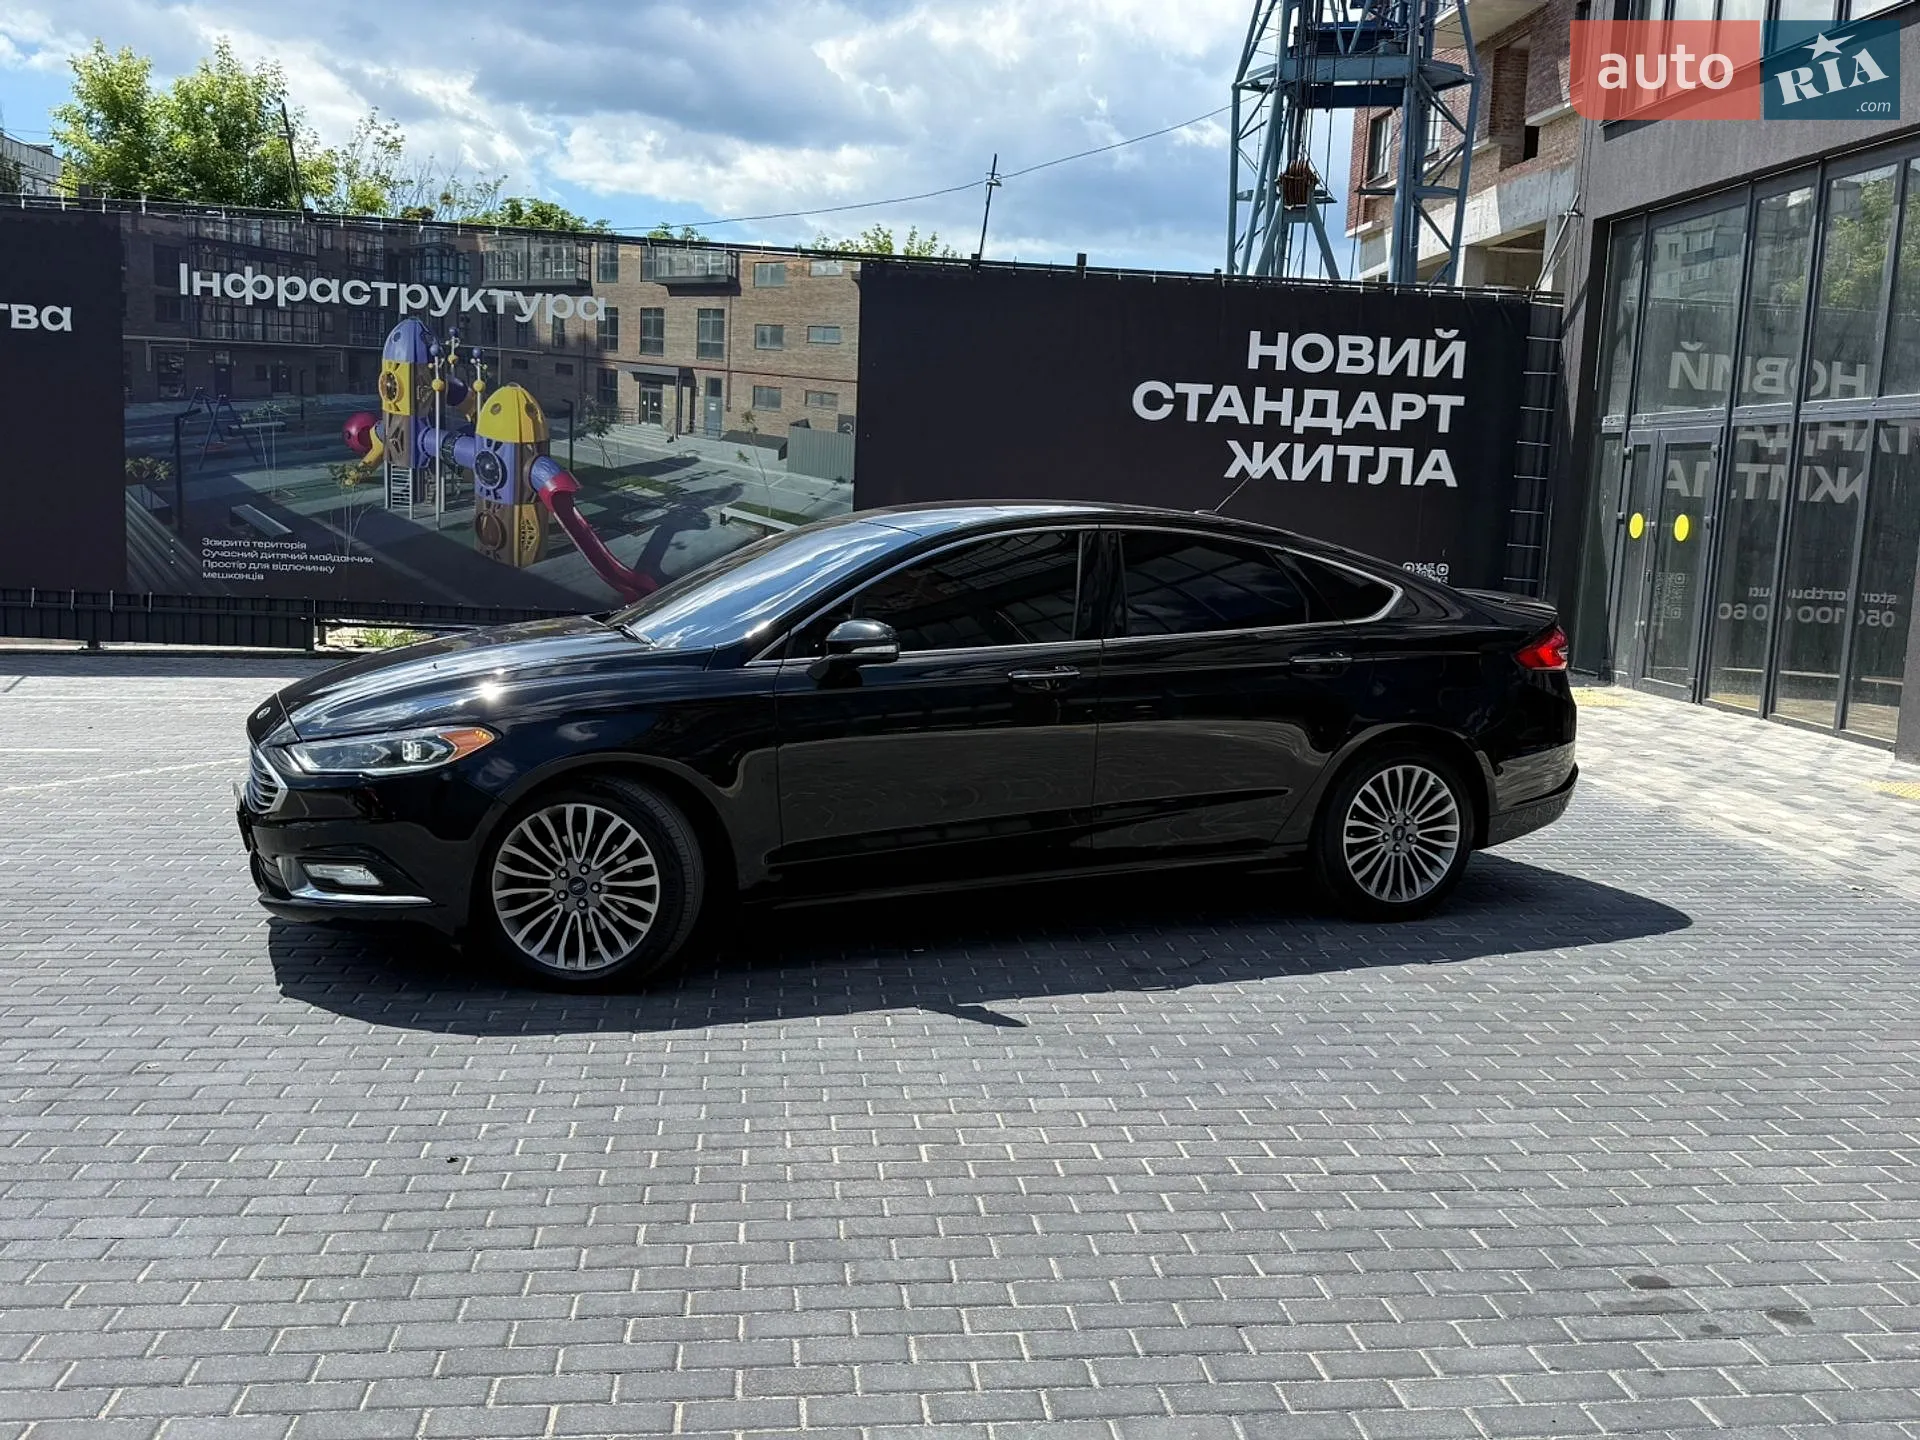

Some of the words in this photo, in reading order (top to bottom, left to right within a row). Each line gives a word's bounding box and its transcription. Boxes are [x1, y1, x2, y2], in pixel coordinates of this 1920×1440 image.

[179, 263, 607, 323] Інфраструктура
[0, 303, 72, 332] ва
[1247, 328, 1466, 379] НОВИЙ
[1132, 380, 1466, 436] СТАНДАРТ
[1223, 440, 1458, 488] ЖИТЛА
[202, 537, 250, 548] Закрита
[251, 540, 307, 550] територія
[202, 548, 259, 559] Сучасний
[260, 551, 308, 561] дитячий
[309, 553, 374, 564] майданчик
[202, 559, 247, 570] Простір
[248, 562, 270, 571] для
[272, 563, 335, 575] відпочинку
[202, 571, 264, 581] мешканців
